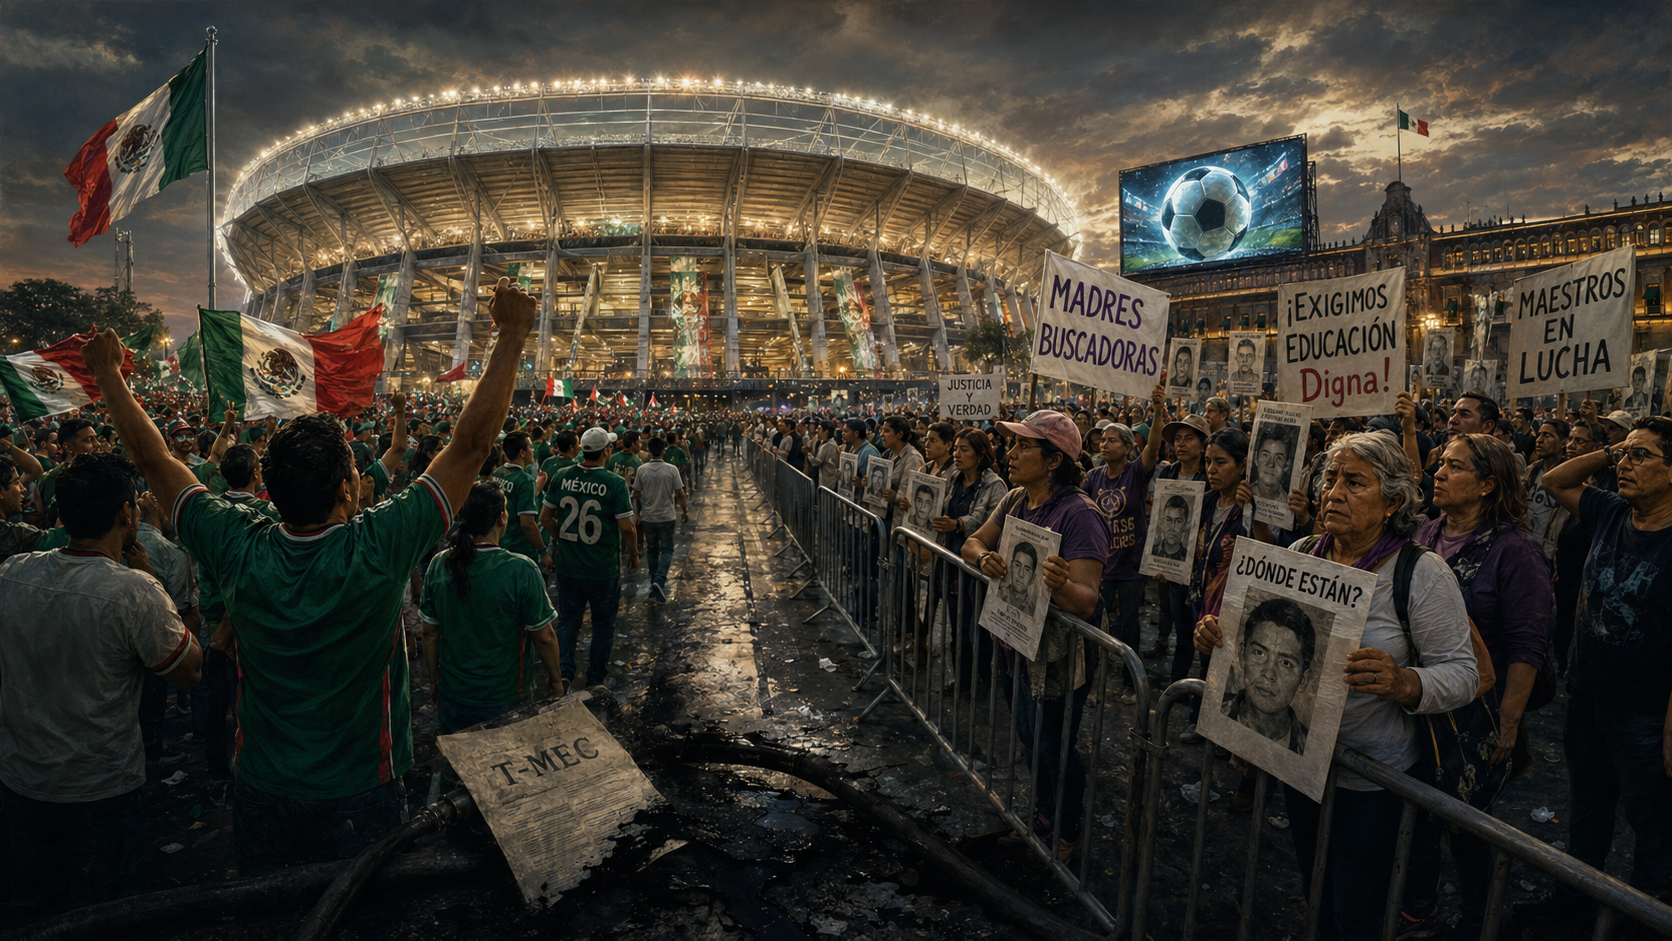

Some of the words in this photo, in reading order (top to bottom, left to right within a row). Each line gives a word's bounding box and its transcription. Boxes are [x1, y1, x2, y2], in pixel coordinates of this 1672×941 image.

[1049, 274, 1144, 330] MADRES
[1287, 283, 1388, 328] ¡EXIGIMOS
[1518, 267, 1626, 320] MAESTROS
[1038, 322, 1160, 377] BUSCADORAS
[1286, 315, 1397, 364] EDUCACIÓN
[1543, 313, 1575, 345] EN
[947, 378, 992, 391] JUSTICIA
[1299, 356, 1391, 408] Digna!
[1519, 338, 1611, 385] LUCHA
[947, 404, 992, 416] VERDAD
[965, 392, 974, 403] Y
[560, 477, 607, 497] MÉXICO
[559, 495, 603, 545] 26
[1236, 555, 1298, 589] ¿DÓNDE
[1297, 571, 1364, 609] ESTÁN?
[490, 736, 599, 787] T-MEC
